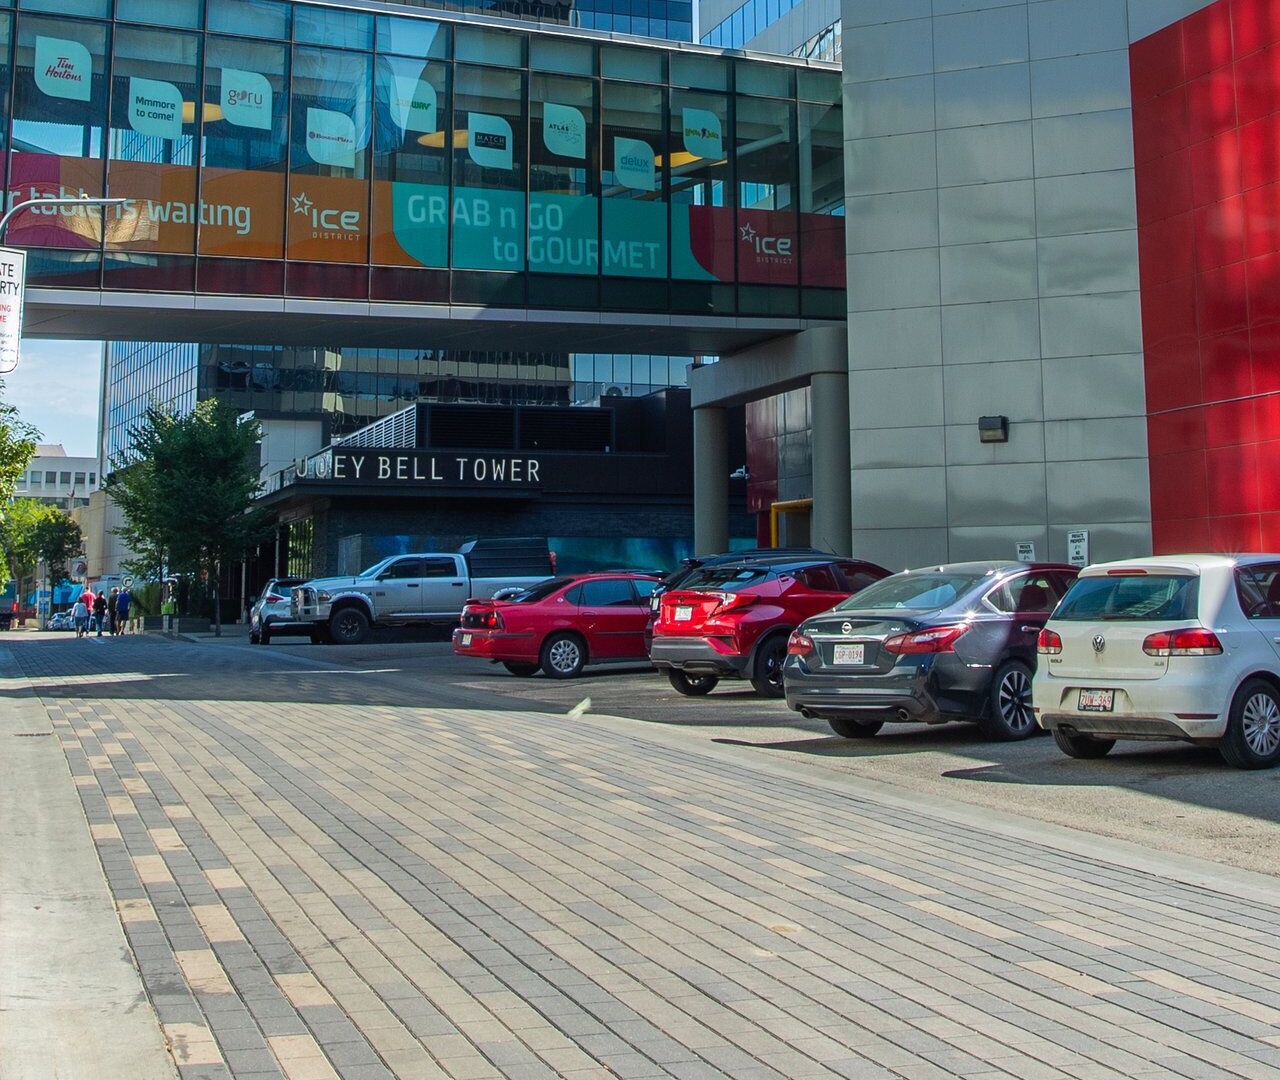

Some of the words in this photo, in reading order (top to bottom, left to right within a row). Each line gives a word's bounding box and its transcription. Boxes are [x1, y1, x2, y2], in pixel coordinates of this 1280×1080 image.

[57, 57, 74, 70] Tim
[45, 65, 82, 81] Hortons
[135, 96, 176, 110] Mmmore
[136, 109, 145, 117] to
[147, 110, 174, 121] come!
[549, 123, 570, 132] ATLAS
[476, 134, 505, 144] MATCH
[621, 155, 649, 168] delux
[31, 186, 101, 218] table
[115, 198, 137, 220] is
[147, 199, 251, 235] waiting
[407, 194, 490, 227] GRAB
[499, 206, 517, 229] n
[528, 203, 563, 231] GO
[312, 231, 361, 241] DISTRICT
[493, 236, 518, 262] to
[528, 236, 660, 269] GOURMET
[755, 256, 792, 264] DISTRICT
[296, 455, 365, 478] JOEY
[377, 456, 443, 480] BELL
[456, 458, 541, 482] TOWER
